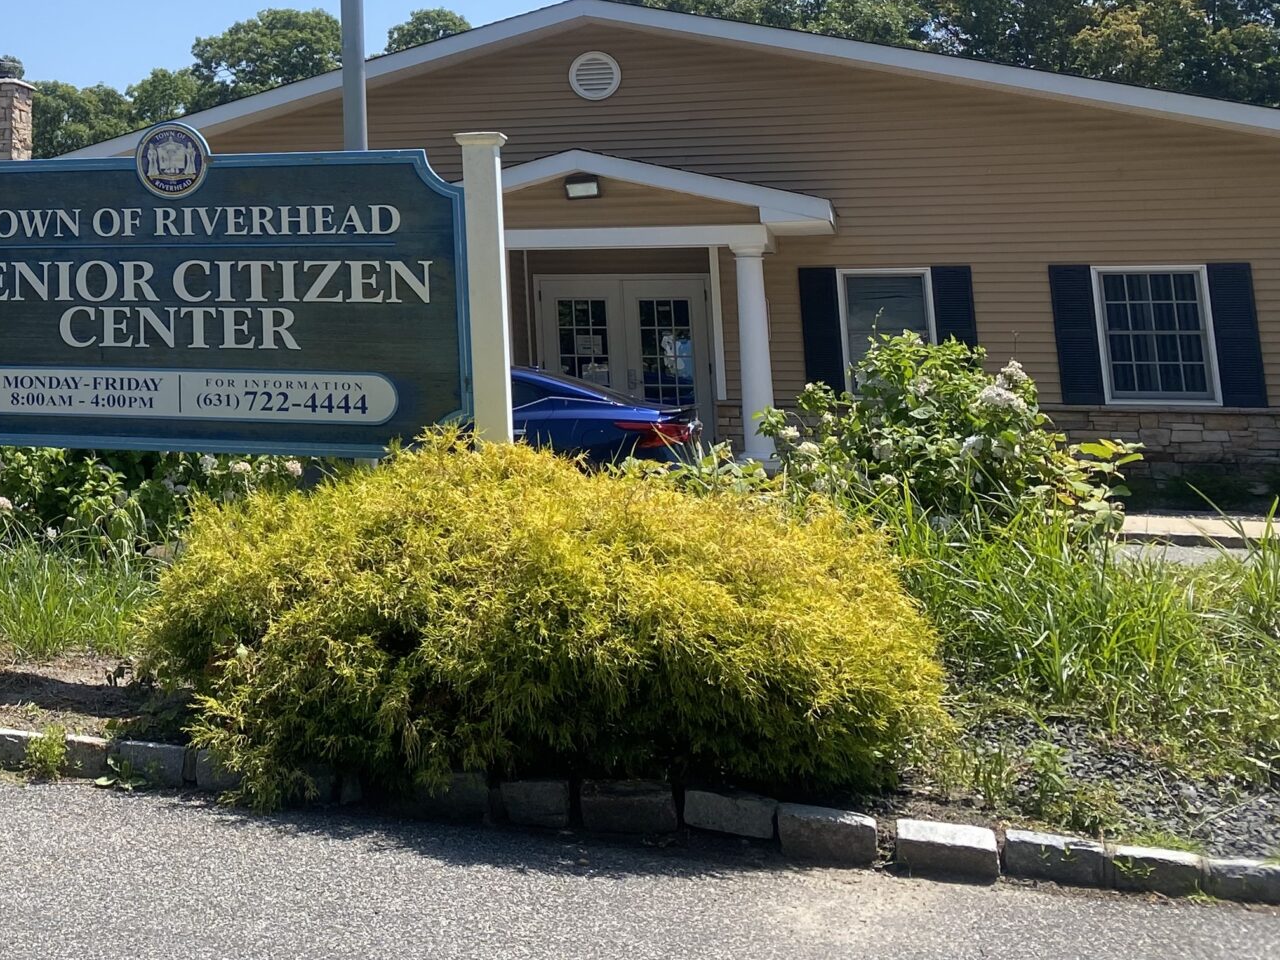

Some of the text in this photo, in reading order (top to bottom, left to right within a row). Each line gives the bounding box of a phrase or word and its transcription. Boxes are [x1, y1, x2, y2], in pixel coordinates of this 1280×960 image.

[155, 131, 175, 140] TOWN
[154, 178, 192, 191] RIVERHEAD
[92, 208, 142, 237] OF
[153, 204, 401, 236] RIVERHEAD
[172, 260, 433, 304] CITIZEN
[59, 306, 301, 350] CENTER
[2, 376, 163, 391] MONDAY-FRIDAY
[205, 378, 364, 391] FOR INFORMATION
[10, 392, 73, 406] 8:00AM
[90, 394, 154, 409] 4:00PM
[196, 391, 368, 415] (631) 722-4444
